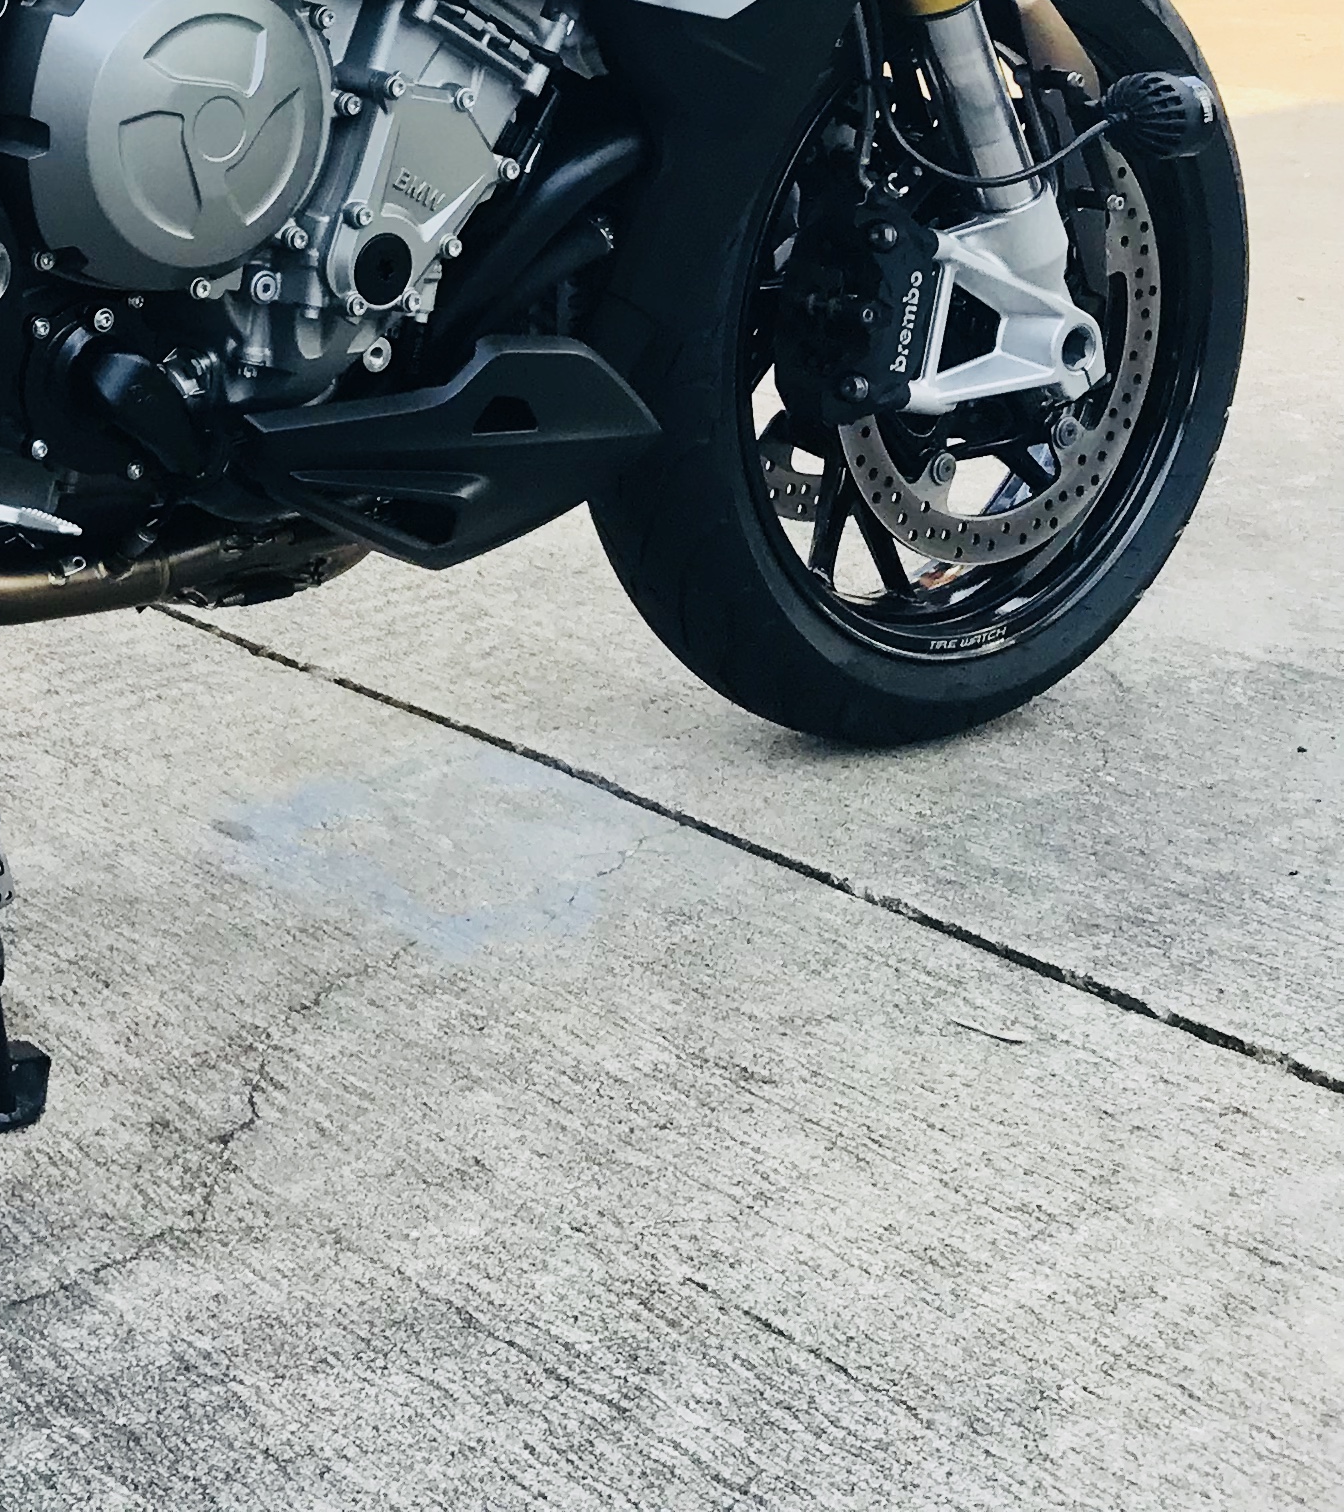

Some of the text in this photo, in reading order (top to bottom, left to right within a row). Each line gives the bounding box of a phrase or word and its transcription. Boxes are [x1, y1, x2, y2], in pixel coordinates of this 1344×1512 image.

[392, 167, 447, 212] BMW
[889, 270, 924, 373] brembo
[929, 639, 958, 650] TIRE
[960, 626, 1007, 648] WATCH
